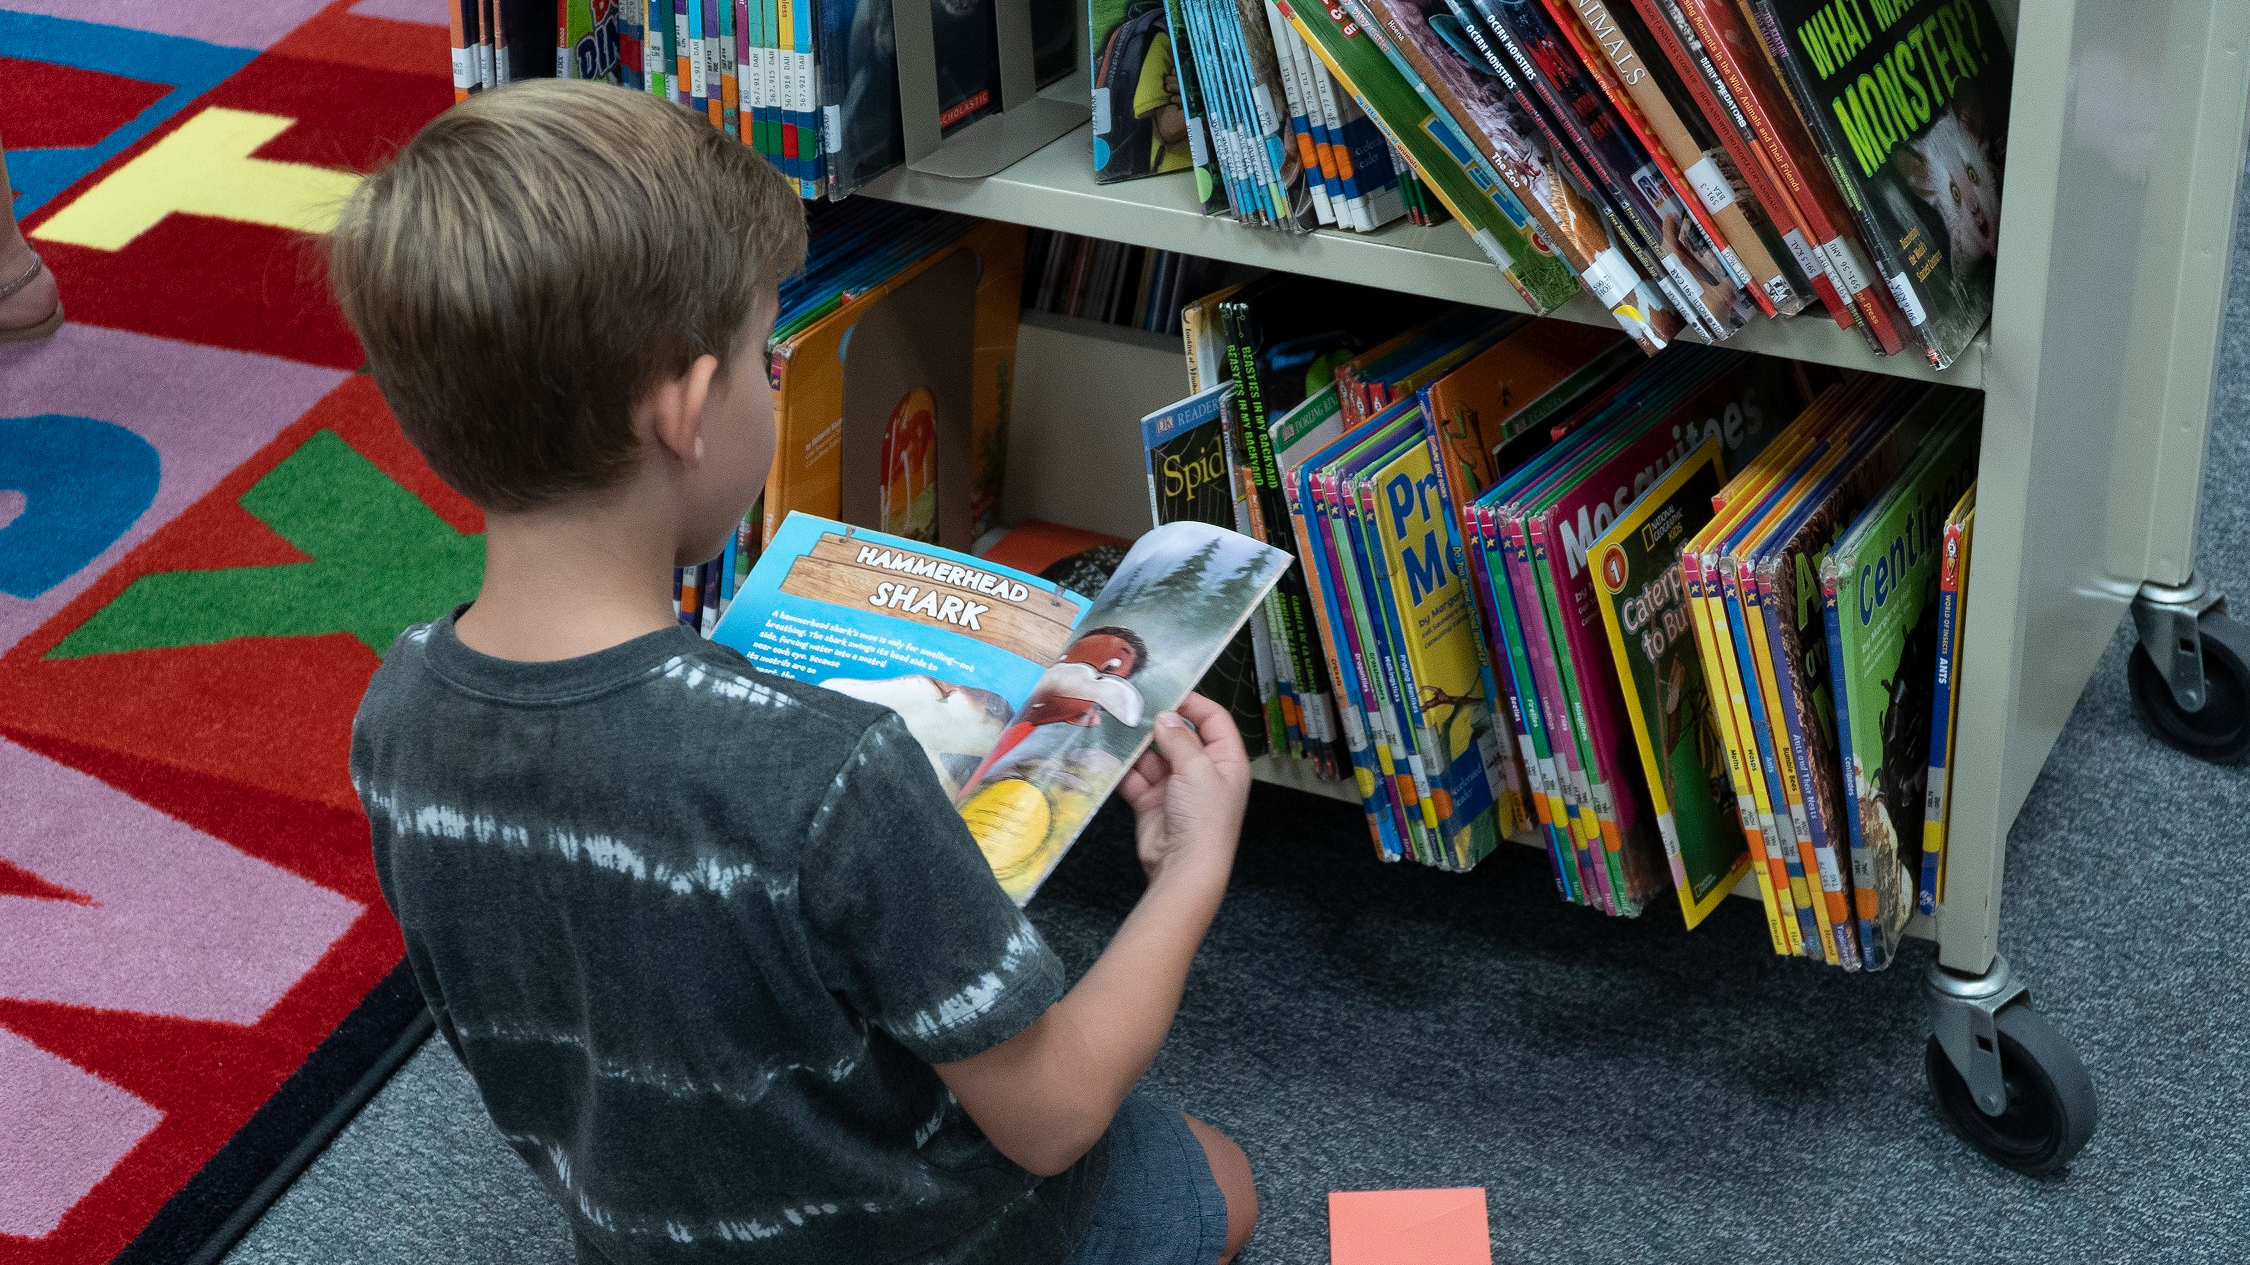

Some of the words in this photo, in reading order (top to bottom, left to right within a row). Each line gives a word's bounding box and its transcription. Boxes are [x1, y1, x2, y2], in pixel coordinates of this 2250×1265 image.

[1349, 6, 1372, 29] Bitsy
[1367, 26, 1393, 53] Cuties
[1386, 20, 1407, 42] Hoena
[1763, 12, 1777, 28] JESS
[1692, 15, 1720, 52] Moments
[1767, 27, 1793, 58] KEATING
[1798, 0, 1872, 80] WHAT
[1466, 25, 1489, 54] OCEAN
[1484, 50, 1516, 89] MONSTERS
[1486, 15, 1509, 44] OCEAN
[1504, 40, 1536, 80] MONSTERS
[1715, 51, 1725, 61] in
[1282, 67, 1291, 82] KLI
[1301, 71, 1309, 86] KLI
[1719, 60, 1733, 75] the
[768, 70, 776, 103] 567.915
[784, 76, 792, 108] 567.918
[1318, 79, 1327, 94] KLI
[1642, 3, 1660, 26] ABOUT
[1656, 24, 1678, 54] ANIMALS
[1698, 90, 1712, 108] HOW
[1708, 106, 1722, 122] AND
[1717, 120, 1731, 136] WHY
[1733, 144, 1751, 168] PEOPLE
[1747, 166, 1762, 184] COPY
[1699, 56, 1718, 80] DEADLY
[1712, 78, 1749, 128] PREDATORS
[1727, 74, 1745, 95] Wild:
[1832, 0, 1991, 178] MONSTER?
[1739, 94, 1764, 127] Animals
[1758, 126, 1773, 143] and
[1395, 144, 1420, 169] animals
[1768, 142, 1785, 164] Their
[1490, 152, 1509, 171] The
[1504, 168, 1524, 188] Zoo
[1780, 163, 1803, 192] Friends
[1700, 181, 1719, 207] 591.3
[1712, 184, 1726, 201] BEA
[1625, 206, 1637, 219] Free
[1608, 213, 1620, 226] Free
[1615, 224, 1639, 252] Augmented
[1644, 263, 1658, 279] App
[1790, 238, 1805, 257] KAL
[1829, 242, 1842, 259] AMU
[1801, 254, 1817, 275] 591.5
[1817, 252, 1829, 268] DEL
[1670, 268, 1685, 286] CAR
[1736, 266, 1750, 282] 591
[1828, 269, 1849, 300] 591.53
[1839, 260, 1861, 291] 591.56
[1597, 283, 1614, 297] HOE
[1665, 290, 1680, 308] CAR
[1682, 284, 1694, 298] 591
[1677, 306, 1689, 319] 591
[1863, 302, 1879, 325] Press
[1226, 344, 1245, 396] BEASTIES
[1240, 346, 1261, 398] BEASTIES
[1238, 399, 1248, 411] IN
[1252, 401, 1263, 412] IN
[1156, 416, 1174, 434] DK
[1240, 412, 1251, 429] MY
[1255, 415, 1266, 431] MY
[1244, 431, 1264, 486] BACKYARD
[1258, 433, 1278, 489] BACKYARD
[1434, 463, 1443, 478] BOLT
[1438, 478, 1448, 498] BOOKS
[1652, 504, 1675, 530] NATIONAL
[1653, 508, 1683, 541] GEOGRAPHIC
[1452, 545, 1462, 560] Do
[856, 546, 1028, 602] HAMMERHEAD
[1455, 560, 1467, 577] You
[1610, 561, 1620, 584] 1
[868, 582, 988, 631] SHARK
[1944, 594, 1952, 619] WORLD
[772, 610, 779, 618] A
[779, 611, 830, 630] hammerhead
[829, 623, 858, 638] shark's
[859, 632, 878, 642] nose
[878, 636, 887, 644] is
[888, 638, 904, 650] only
[906, 640, 919, 652] for
[1944, 620, 1950, 628] OF
[765, 620, 806, 638] breathing.
[808, 630, 824, 640] The
[824, 633, 848, 646] shark
[848, 640, 876, 654] swings
[876, 646, 889, 656] its
[890, 650, 910, 662] head
[910, 656, 927, 668] side
[928, 662, 939, 672] to
[778, 633, 809, 650] forcing
[809, 642, 834, 654] water
[834, 646, 851, 659] into
[851, 652, 858, 660] a
[858, 654, 888, 669] nostril
[1642, 628, 1666, 662] to
[1942, 628, 1950, 655] INSECTS
[752, 641, 772, 652] near
[772, 646, 792, 657] each
[792, 650, 808, 661] eye.
[808, 654, 841, 668] Because
[760, 654, 793, 668] nostrils
[793, 662, 806, 670] are
[806, 666, 817, 674] so
[1331, 658, 1341, 687] Crickets
[1353, 652, 1371, 693] Dragonflies
[1368, 652, 1387, 701] Grasshoppers
[1383, 655, 1402, 702] Walkingsticks
[1938, 658, 1948, 684] ANTS
[1397, 654, 1412, 683] Praying
[1406, 684, 1420, 714] Mantises
[1509, 695, 1522, 722] Beetles
[1526, 698, 1539, 728] Fireflies
[1559, 714, 1568, 731] Flies
[1792, 733, 1804, 754] Ants
[1730, 749, 1740, 770] Moths
[1747, 749, 1758, 772] Wasps
[1765, 756, 1775, 773] Ants
[1782, 747, 1794, 773] Bumble
[1788, 775, 1798, 792] Bees
[1797, 755, 1808, 771] and
[1801, 773, 1813, 795] Their
[1841, 756, 1858, 796] Centipedes
[1806, 796, 1818, 819] Nests
[1770, 919, 1782, 946] Howard
[1824, 929, 1835, 956] Howard
